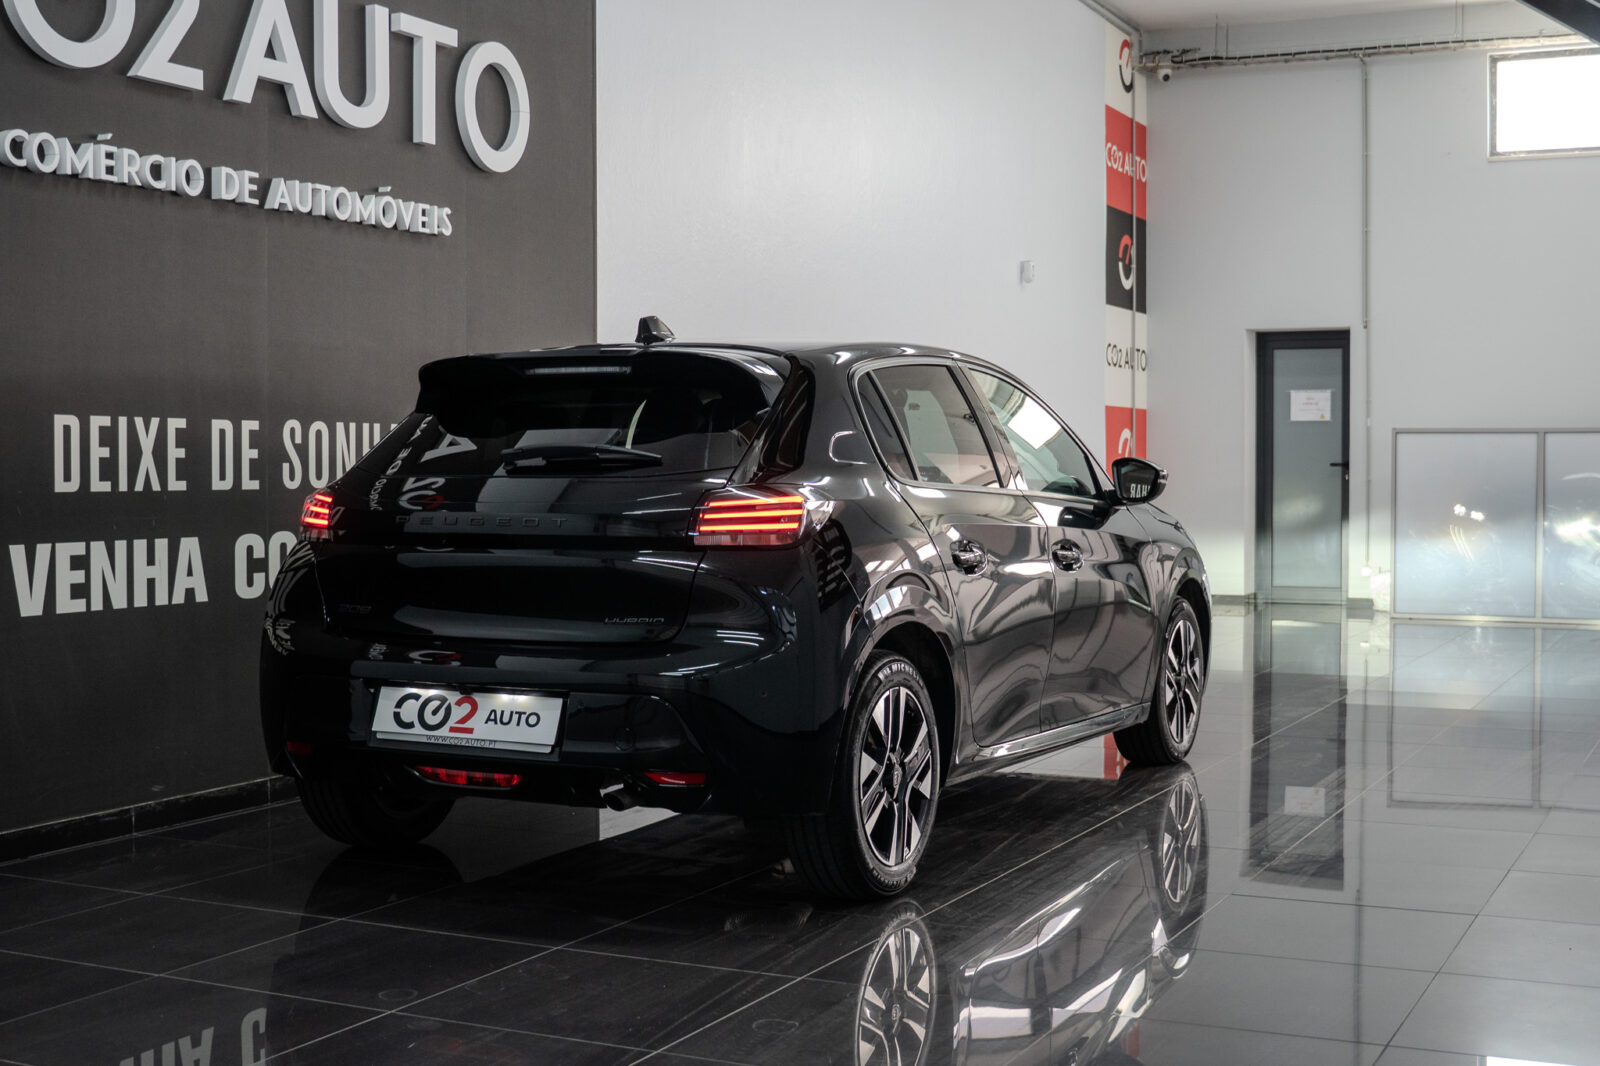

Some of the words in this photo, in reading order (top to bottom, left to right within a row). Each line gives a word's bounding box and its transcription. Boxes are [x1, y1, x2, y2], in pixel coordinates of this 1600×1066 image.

[0, 128, 205, 197] COMÉRCIO
[211, 166, 260, 205] DE
[264, 177, 453, 237] AUTOMÓVEIS
[53, 413, 188, 493] DEIXE
[211, 418, 260, 491] DE
[395, 514, 568, 529] PEUGEOT
[9, 536, 209, 618] VENHA
[393, 692, 479, 735] CO2
[484, 708, 541, 729] AUTO
